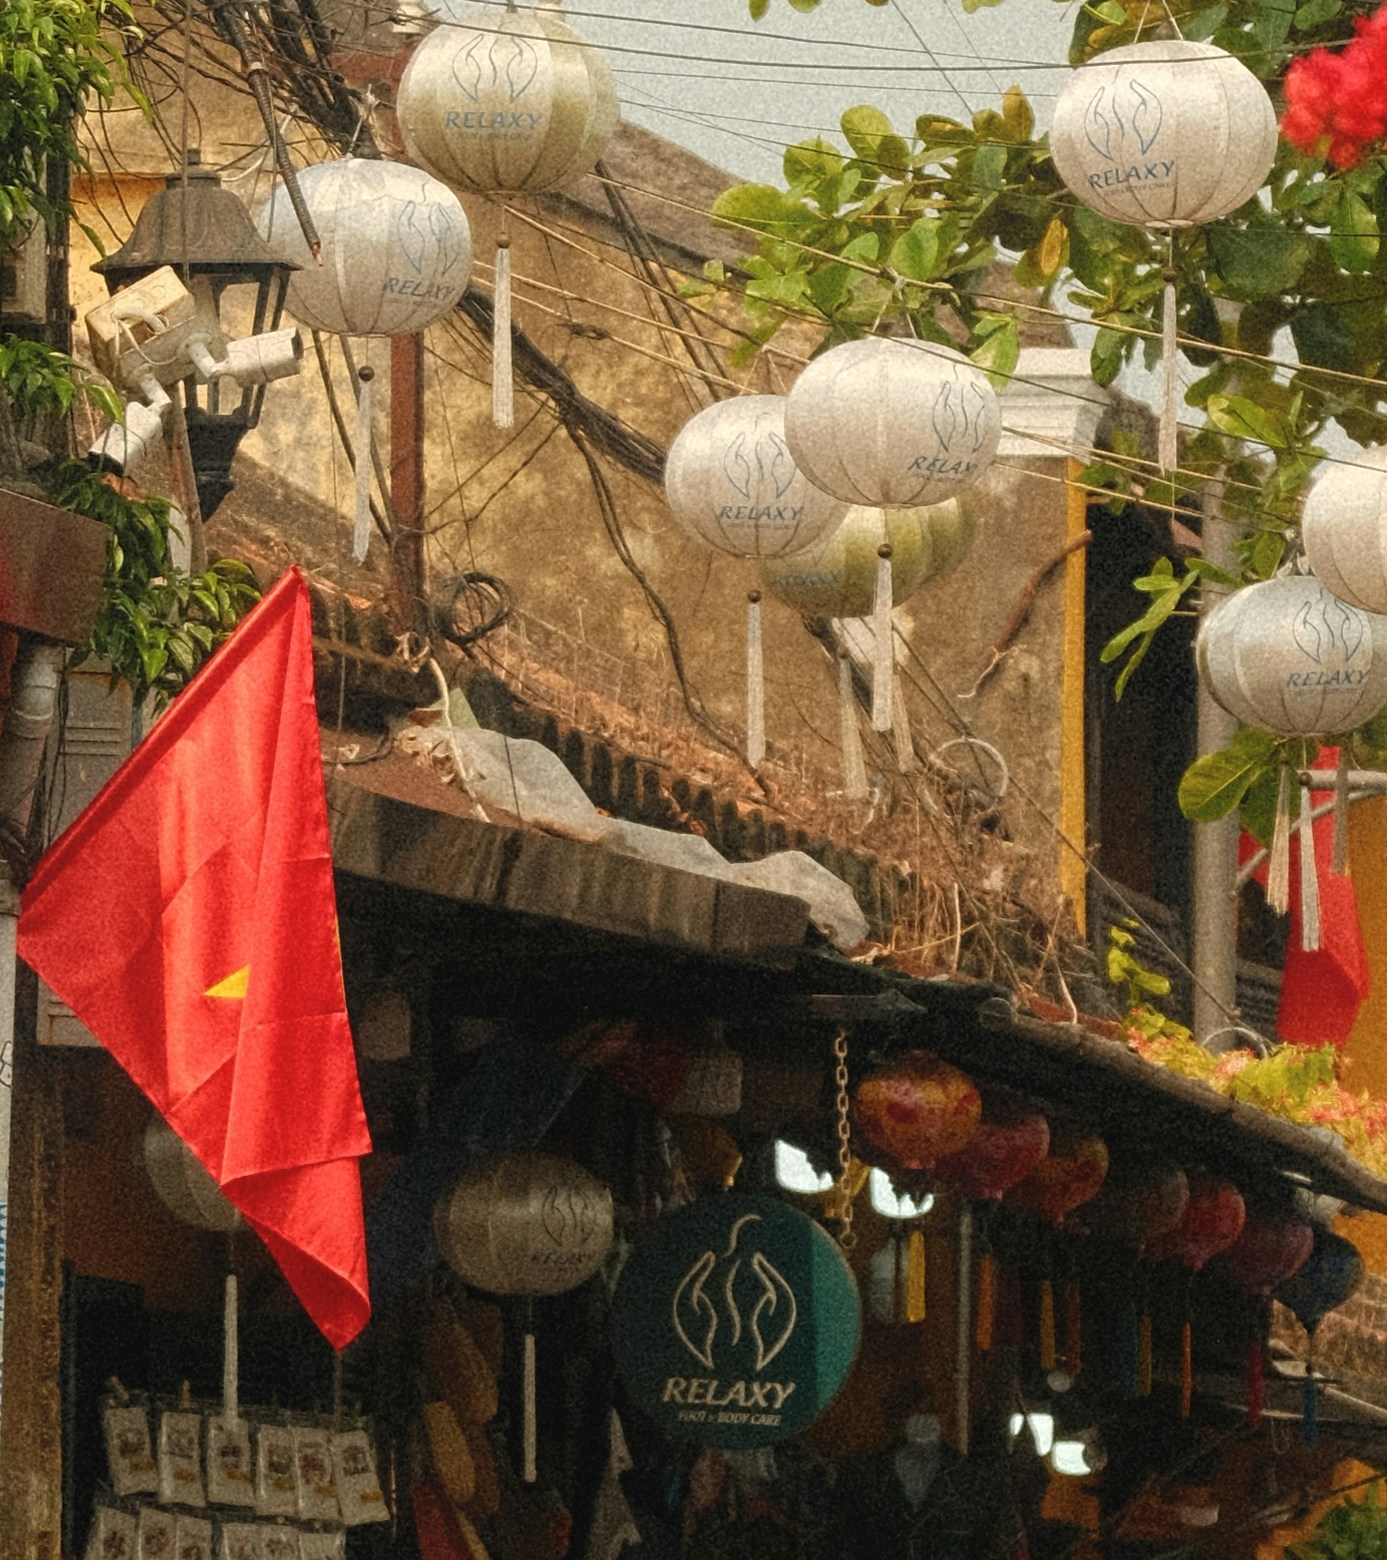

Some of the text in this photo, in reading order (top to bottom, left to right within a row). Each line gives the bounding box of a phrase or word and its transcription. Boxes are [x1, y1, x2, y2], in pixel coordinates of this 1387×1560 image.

[445, 111, 543, 130] RELAXY
[1088, 160, 1175, 190] RELAXY
[719, 505, 804, 521] RELAXY
[1287, 669, 1371, 688] RELAXY
[662, 1377, 796, 1409] RELAXY
[717, 1411, 750, 1424] BODY
[751, 1413, 782, 1427] CARE
